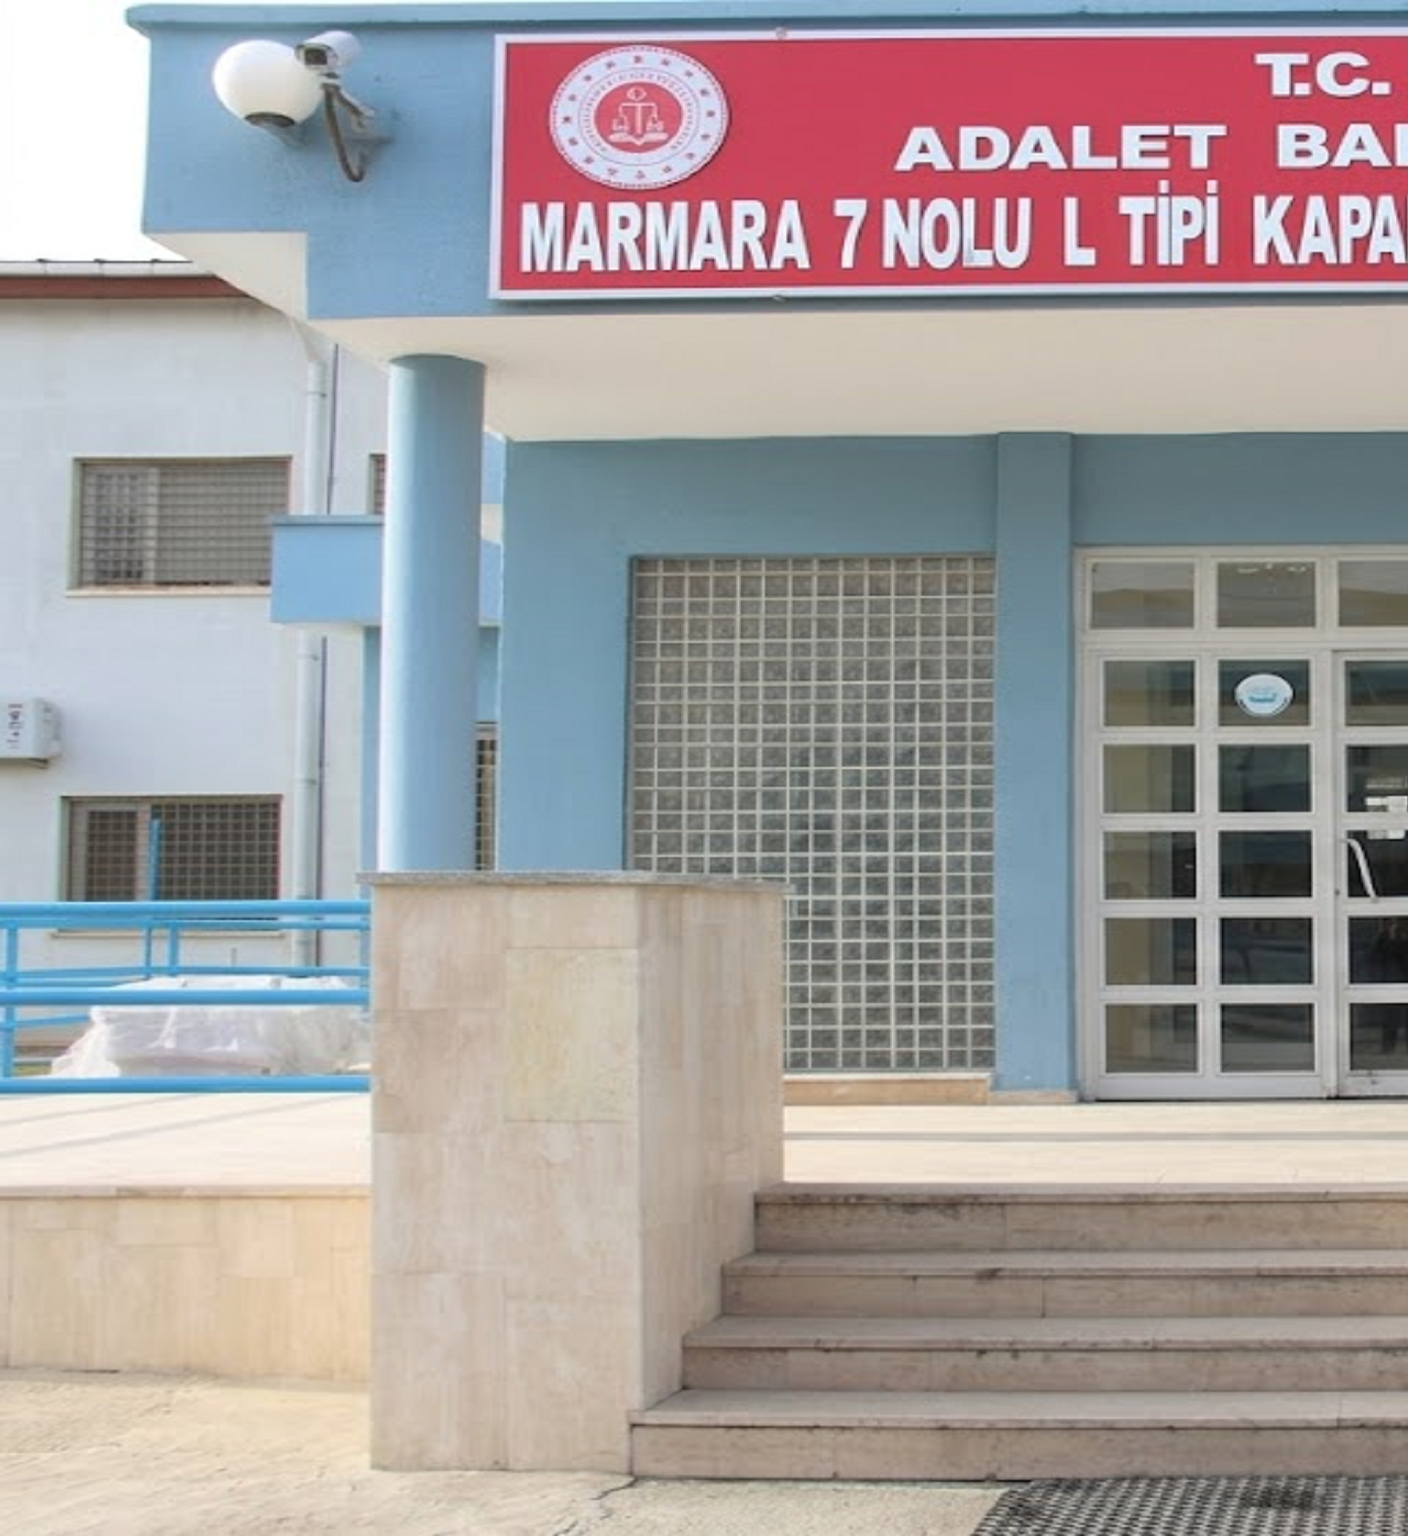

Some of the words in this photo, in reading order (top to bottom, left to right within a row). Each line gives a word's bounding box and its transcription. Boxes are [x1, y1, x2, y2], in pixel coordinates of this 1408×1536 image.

[1255, 52, 1392, 97] T.C.
[894, 125, 1228, 171] ADALET
[520, 201, 811, 272] MARMARA
[833, 198, 868, 269] 7
[882, 197, 1030, 270] NOLU
[1064, 196, 1097, 266] L
[1118, 180, 1220, 266] TİPİ
